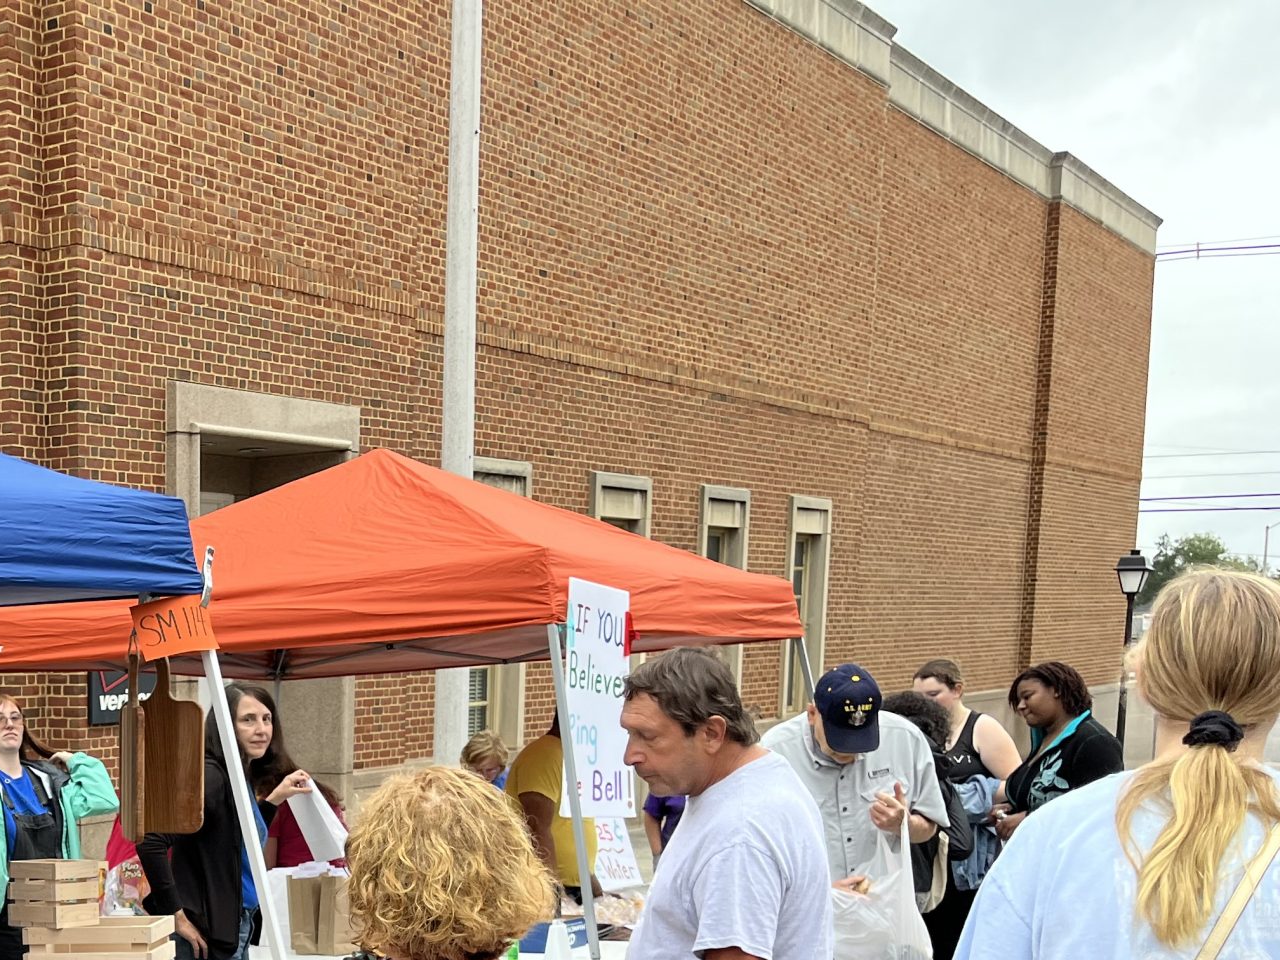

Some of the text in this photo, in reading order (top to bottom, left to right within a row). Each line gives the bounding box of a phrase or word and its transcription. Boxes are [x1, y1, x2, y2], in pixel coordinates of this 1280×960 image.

[140, 608, 182, 647] SM
[597, 607, 624, 647] YOU
[569, 650, 625, 699] Believe
